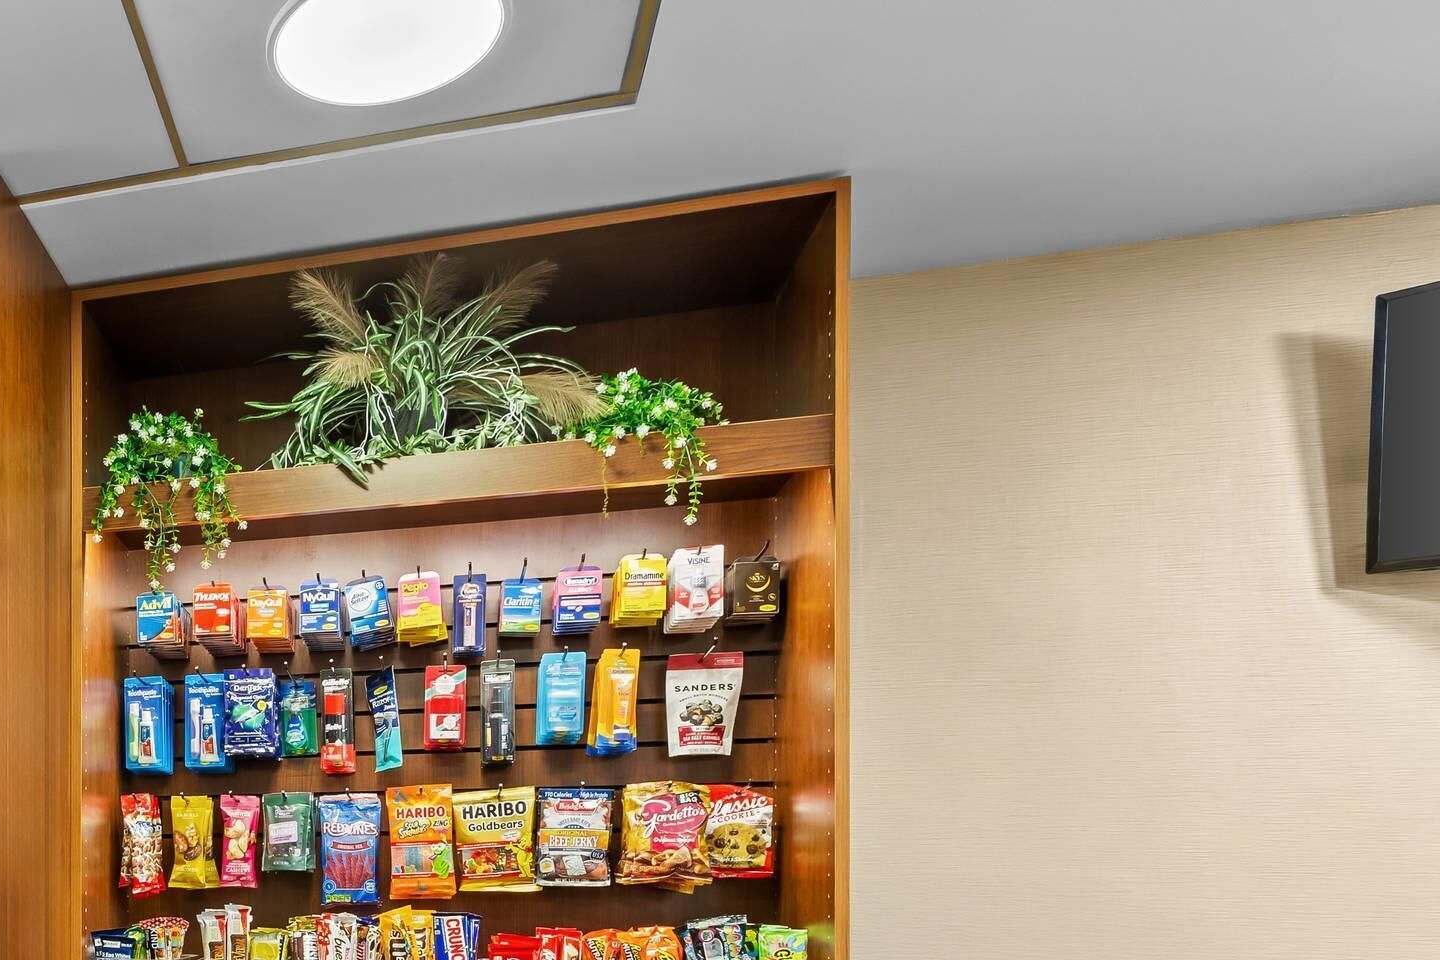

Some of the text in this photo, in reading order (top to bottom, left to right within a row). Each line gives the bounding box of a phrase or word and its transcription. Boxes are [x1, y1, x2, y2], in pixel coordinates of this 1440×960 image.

[624, 571, 664, 581] Dramamine
[140, 596, 172, 611] Advil
[250, 598, 282, 608] DayQuil
[302, 592, 335, 604] NyQuil
[504, 596, 533, 607] Claritin
[674, 683, 734, 692] SANDERS
[396, 807, 445, 819] HARIBO
[462, 801, 527, 820] HARIBO
[710, 795, 768, 819] Classic
[640, 800, 707, 840] Gardetto's
[717, 811, 754, 823] COOKIE
[468, 820, 523, 832] Goldbears
[549, 835, 598, 848] BEEF JERKY
